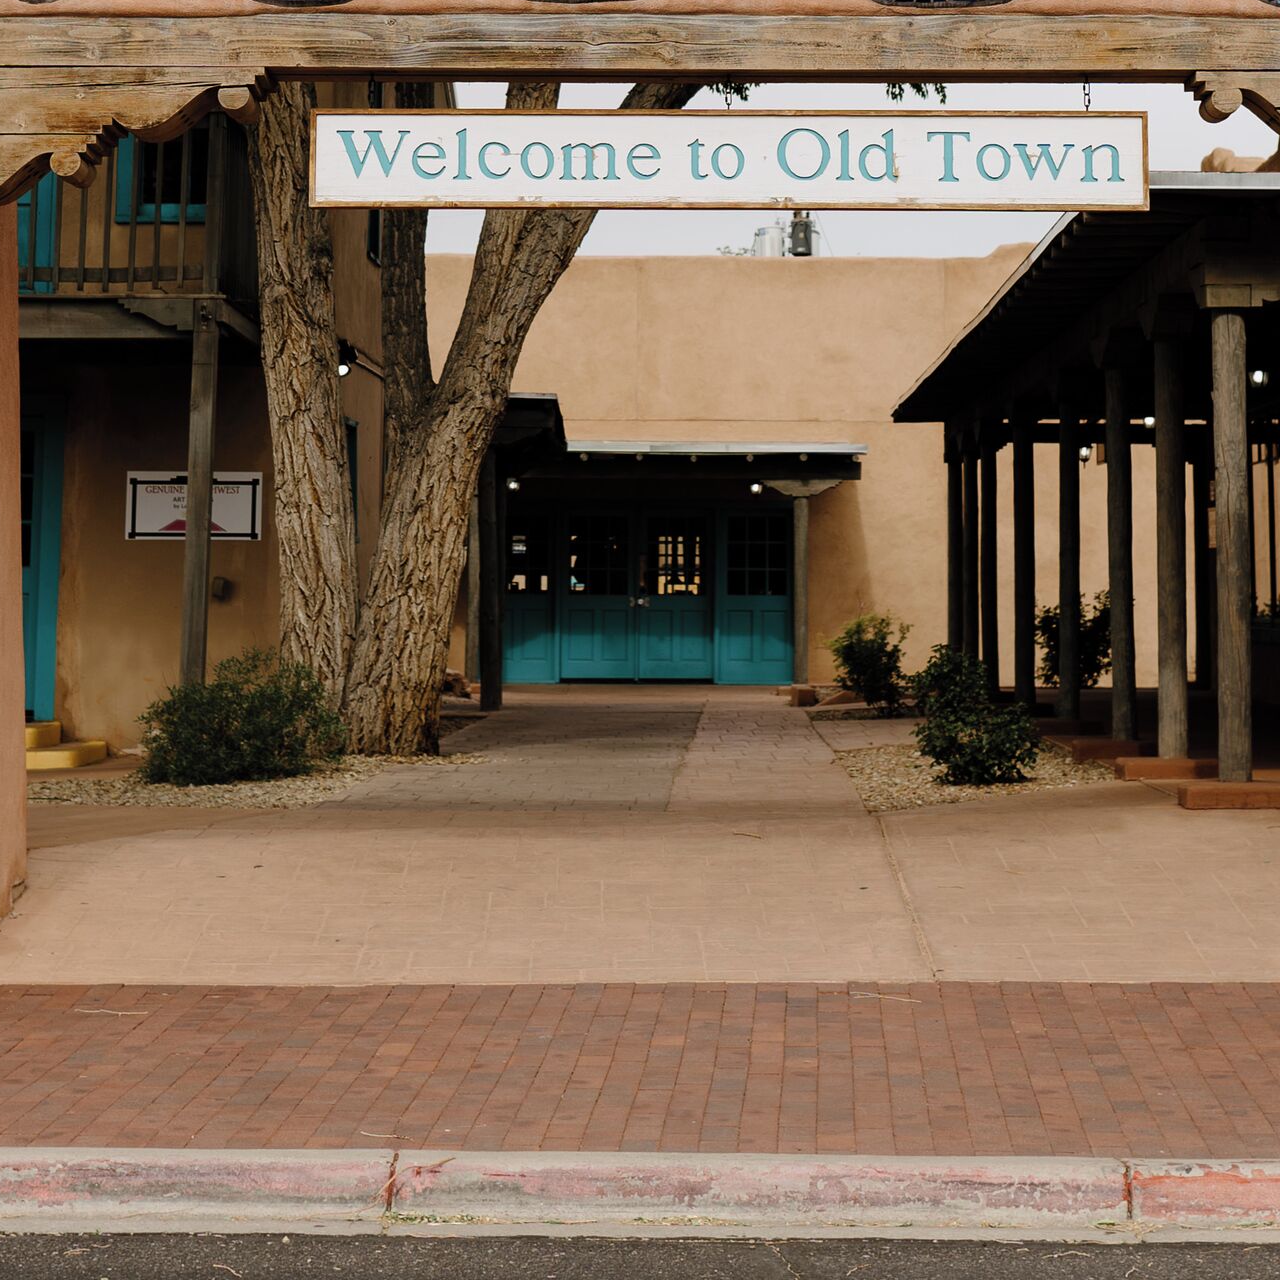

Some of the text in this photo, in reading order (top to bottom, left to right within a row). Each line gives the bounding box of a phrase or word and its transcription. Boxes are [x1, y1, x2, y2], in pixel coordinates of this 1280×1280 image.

[336, 127, 1126, 183] Welcome to Old Town
[145, 486, 185, 494] GENUINE
